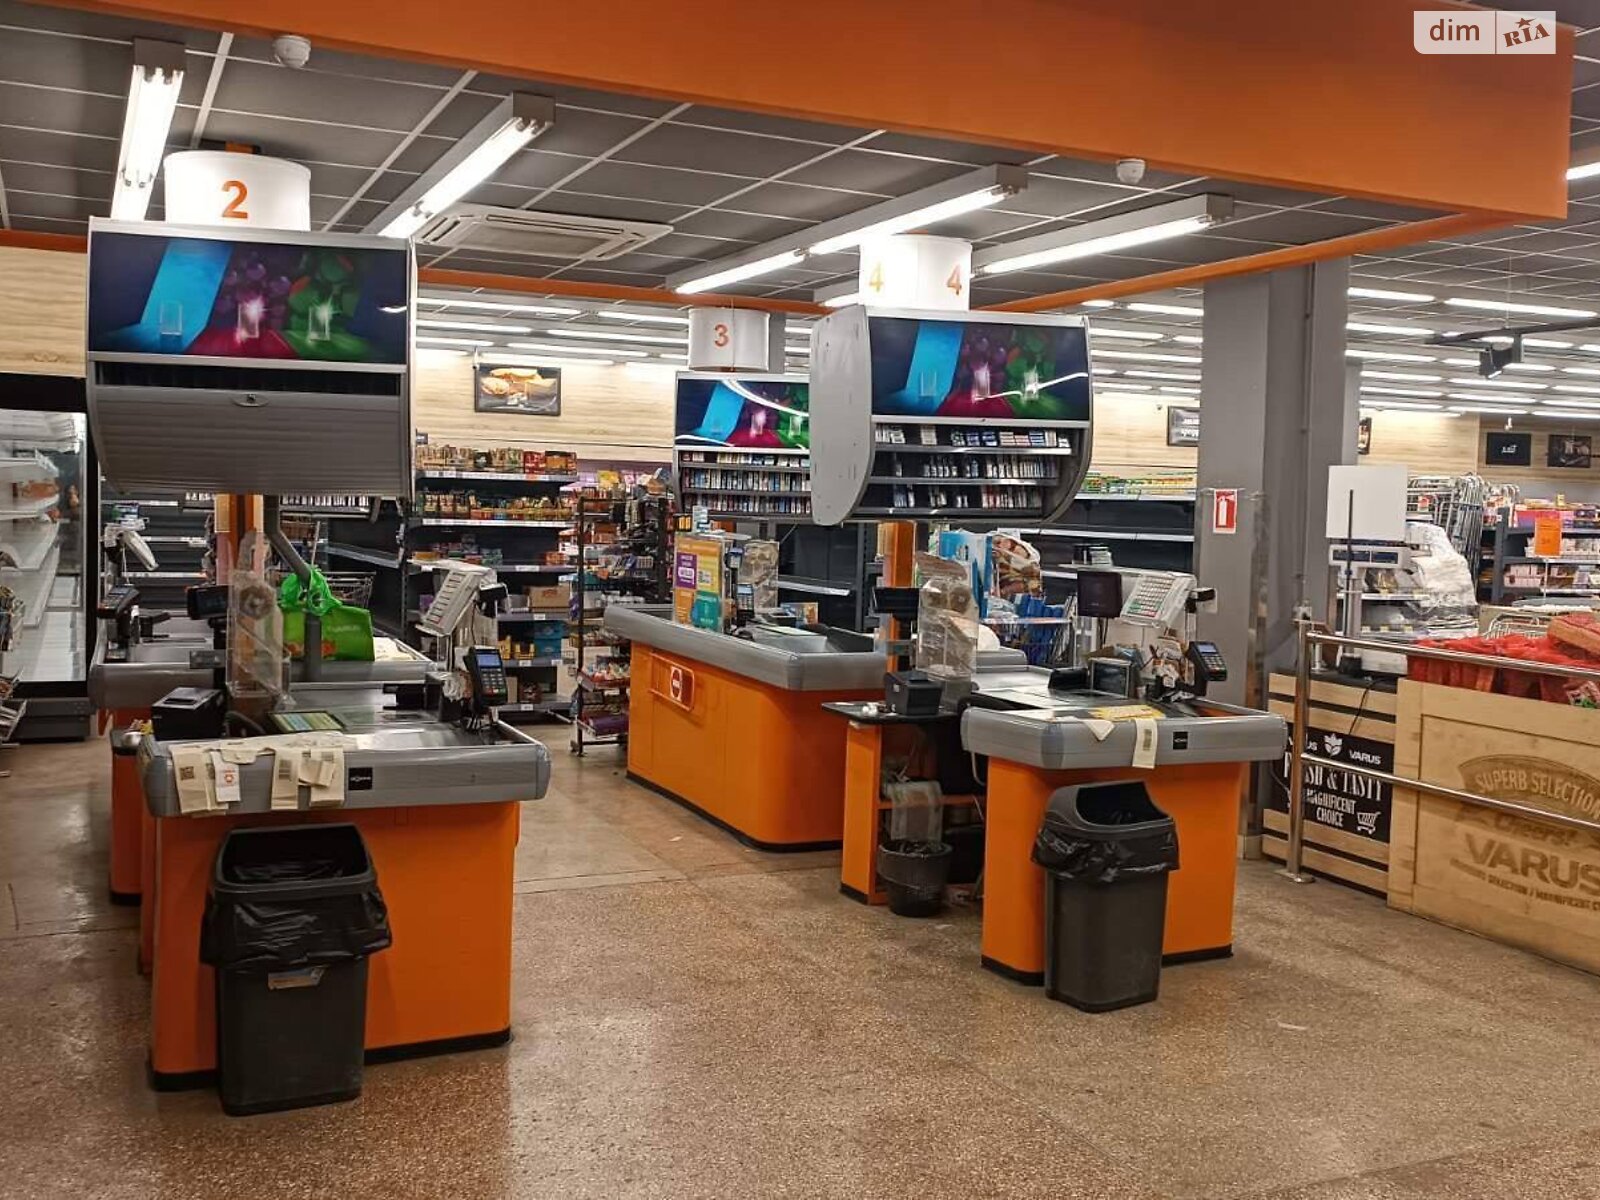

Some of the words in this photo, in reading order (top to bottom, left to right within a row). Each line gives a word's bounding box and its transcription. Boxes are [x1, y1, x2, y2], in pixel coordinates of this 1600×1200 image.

[221, 180, 248, 219] 2
[869, 261, 885, 292] 4
[946, 264, 963, 295] 4
[714, 324, 729, 348] 3
[1349, 749, 1381, 765] VARUS
[1326, 768, 1338, 790] &
[1475, 769, 1527, 794] SUPERB
[1316, 806, 1344, 827] CHOICE
[1464, 833, 1600, 897] VARUS
